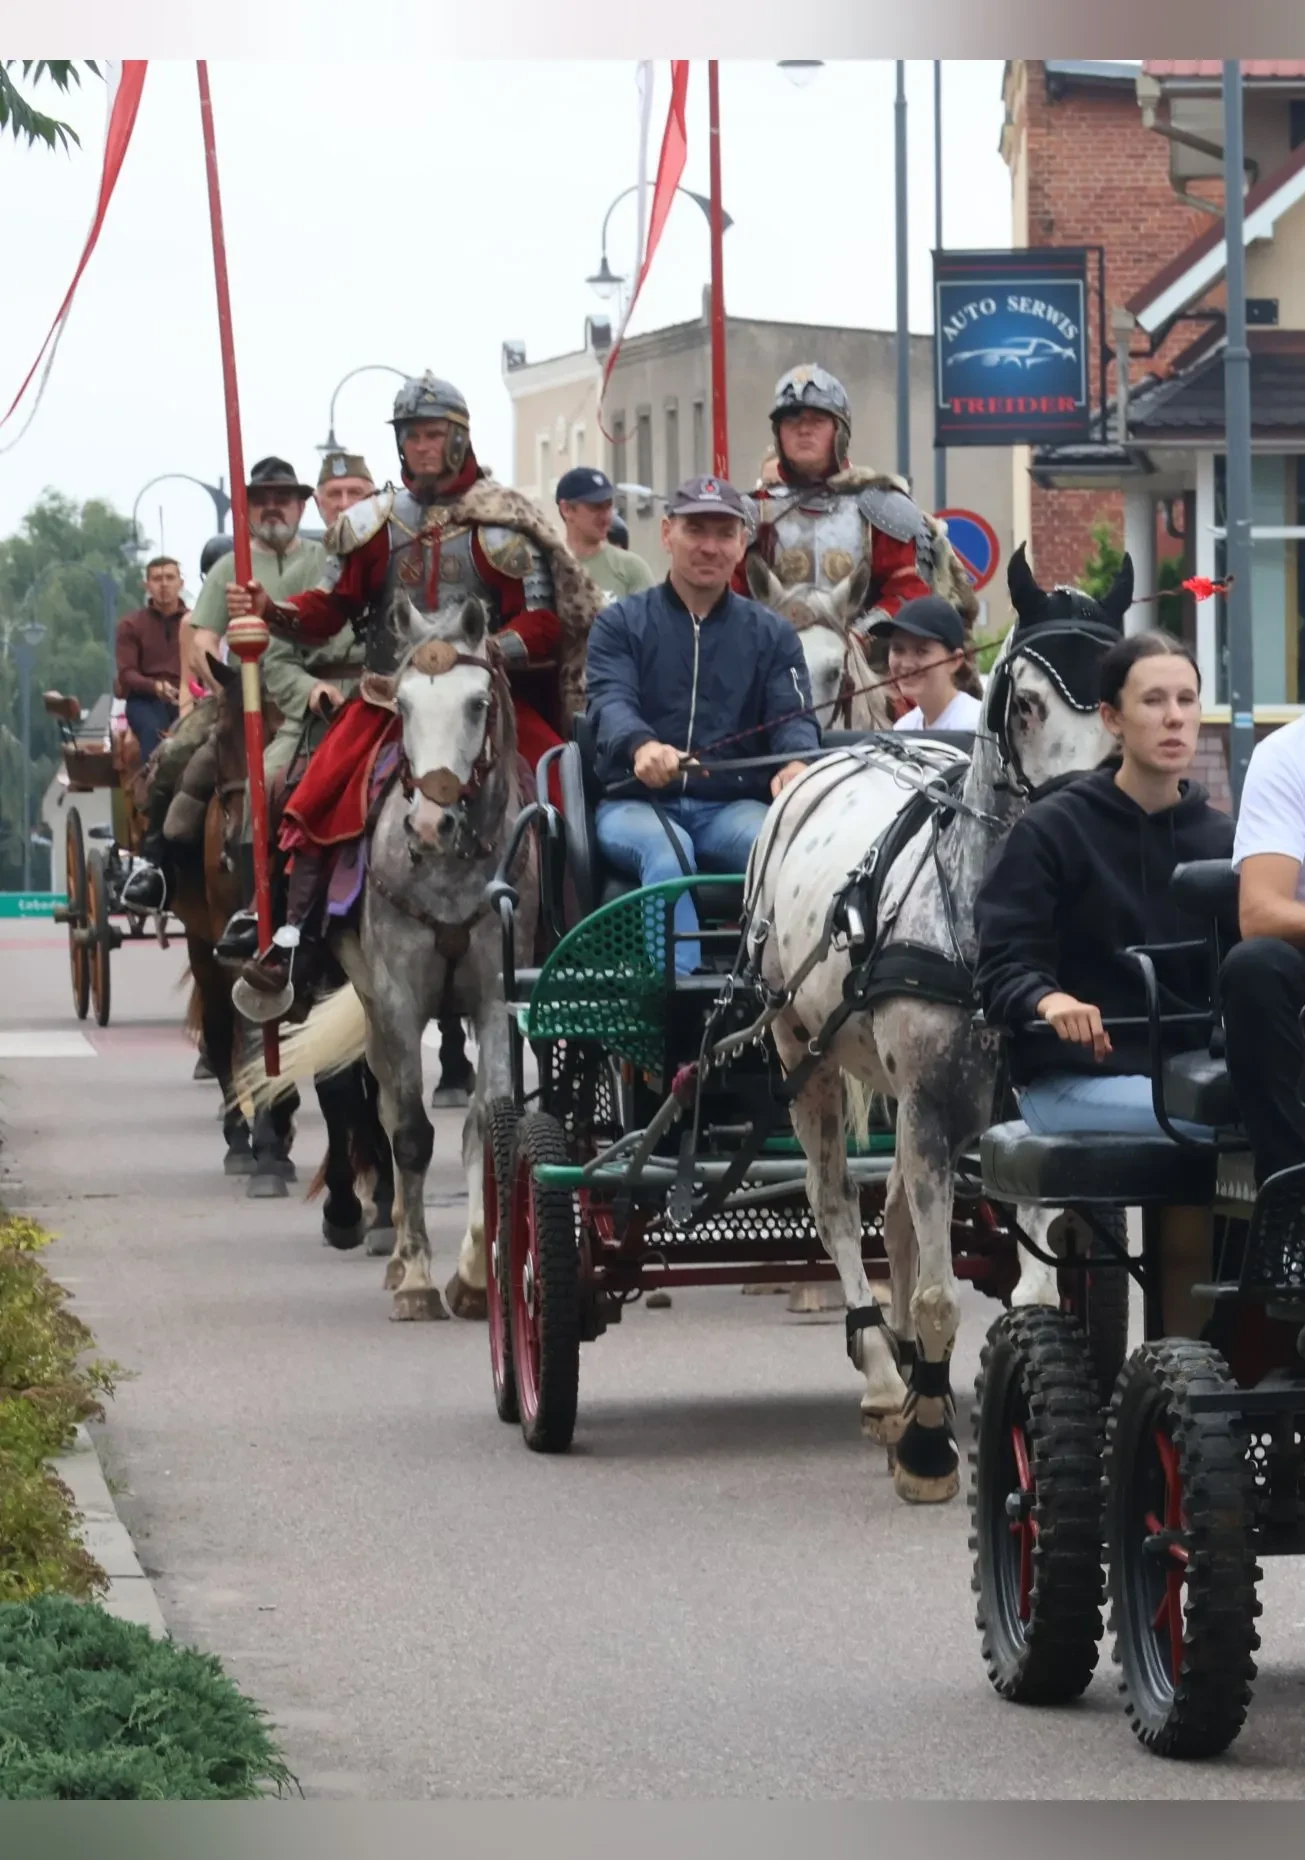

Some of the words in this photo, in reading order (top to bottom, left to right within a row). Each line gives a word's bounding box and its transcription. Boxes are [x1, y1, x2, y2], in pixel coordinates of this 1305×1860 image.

[942, 298, 997, 342] AUTO
[1006, 296, 1079, 341] SERWIS
[950, 396, 1077, 415] TREIDER
